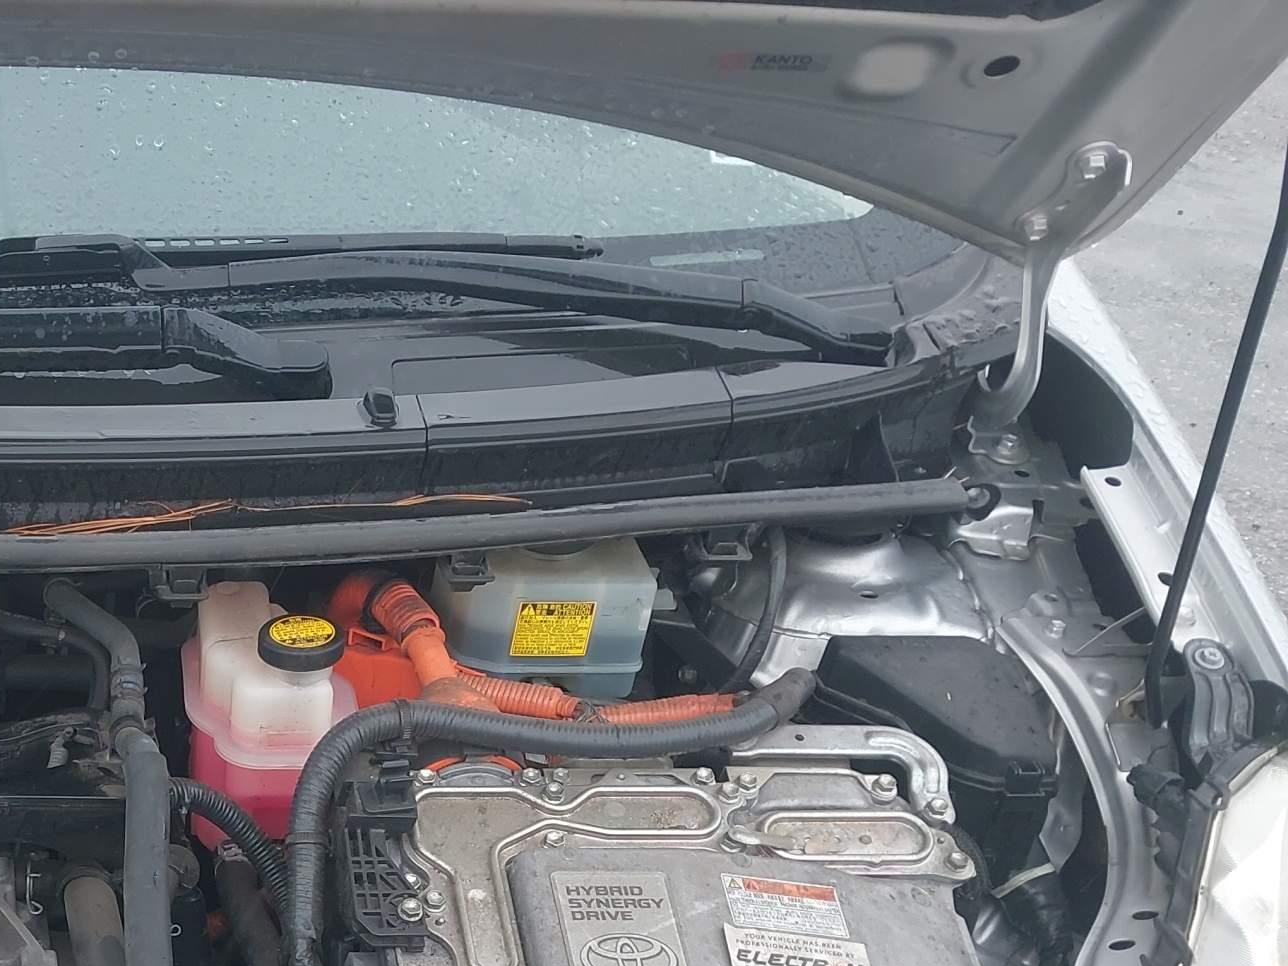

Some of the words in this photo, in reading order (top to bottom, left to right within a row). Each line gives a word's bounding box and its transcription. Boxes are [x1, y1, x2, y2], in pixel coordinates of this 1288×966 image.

[566, 885, 643, 896] HYBRID
[568, 898, 664, 909] SYNERGY
[571, 910, 634, 921] DRIVE
[768, 936, 800, 944] VEHICLE
